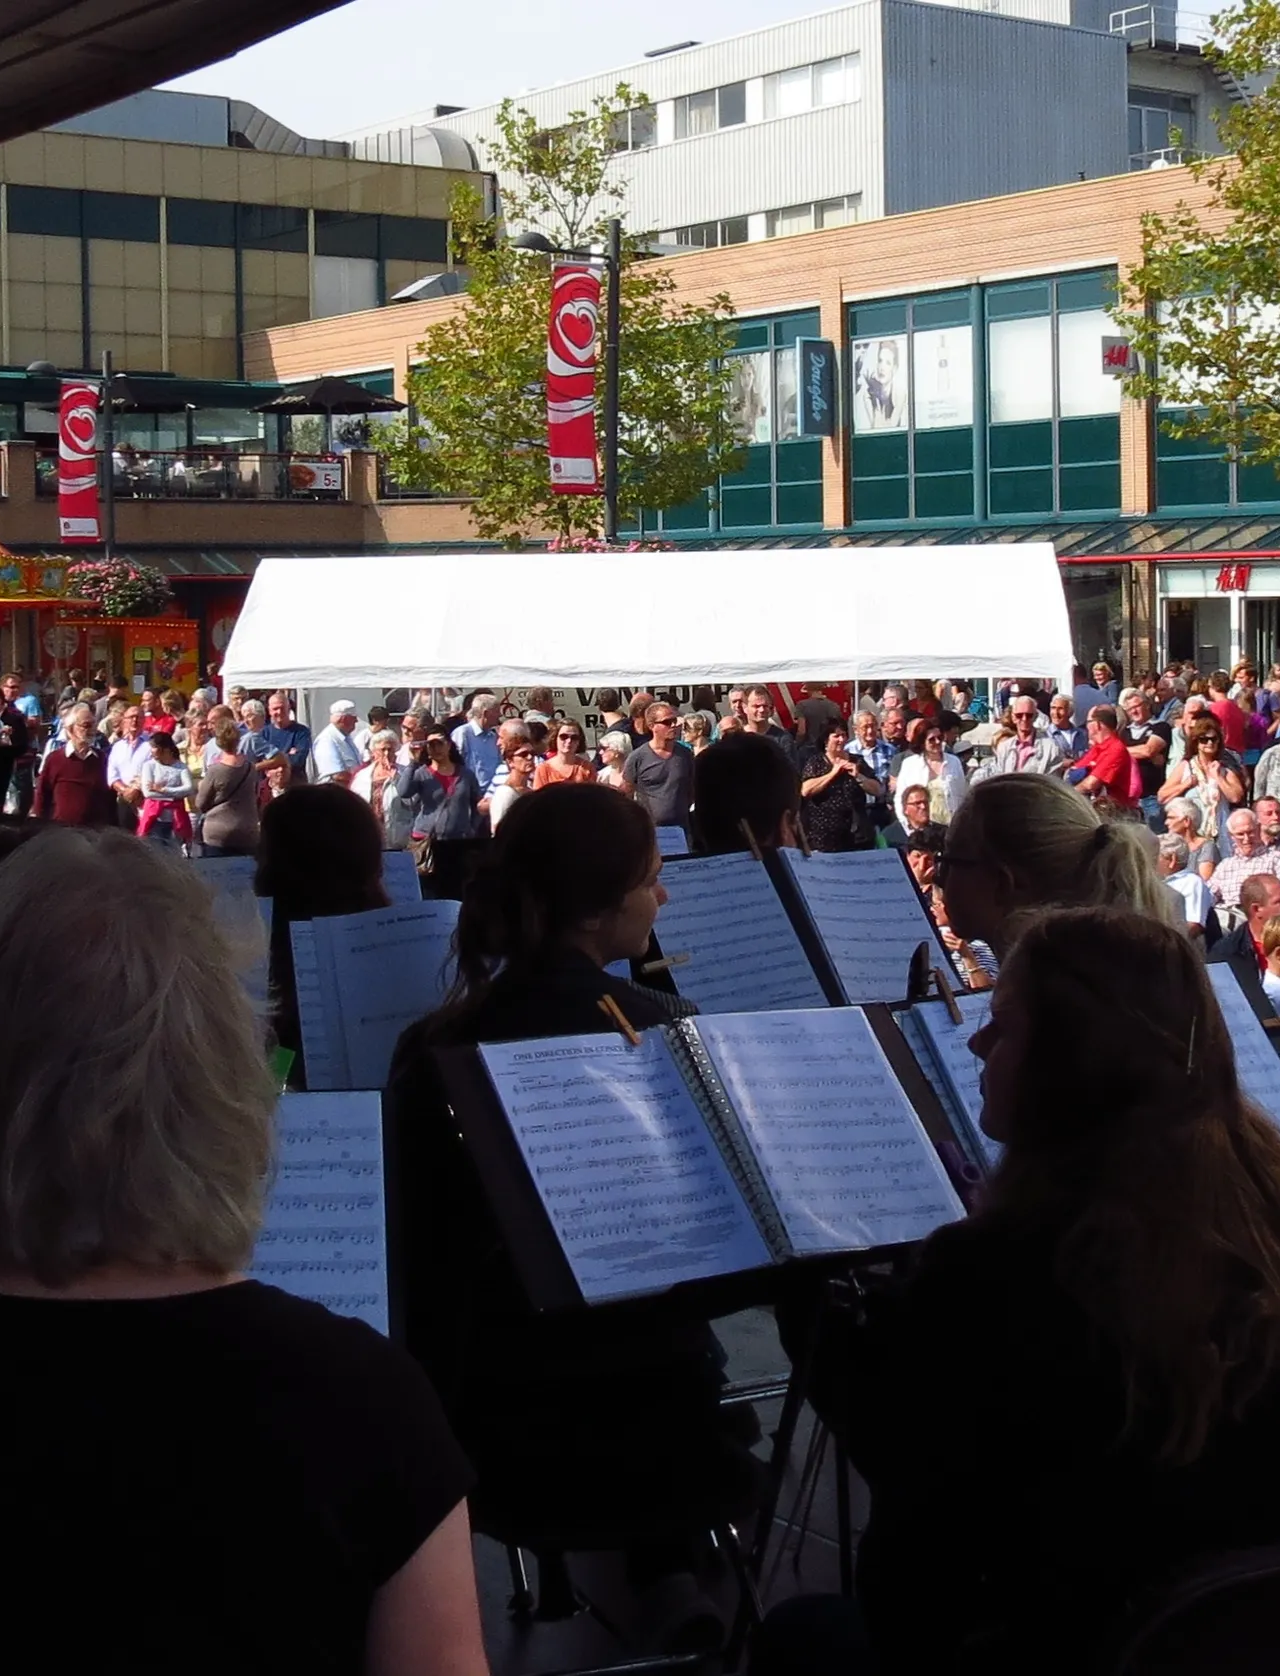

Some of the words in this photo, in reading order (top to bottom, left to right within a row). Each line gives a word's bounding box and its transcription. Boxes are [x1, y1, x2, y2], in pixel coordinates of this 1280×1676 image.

[807, 352, 828, 421] Douglas
[1216, 563, 1252, 592] H&M
[534, 1047, 582, 1060] DIRECTION
